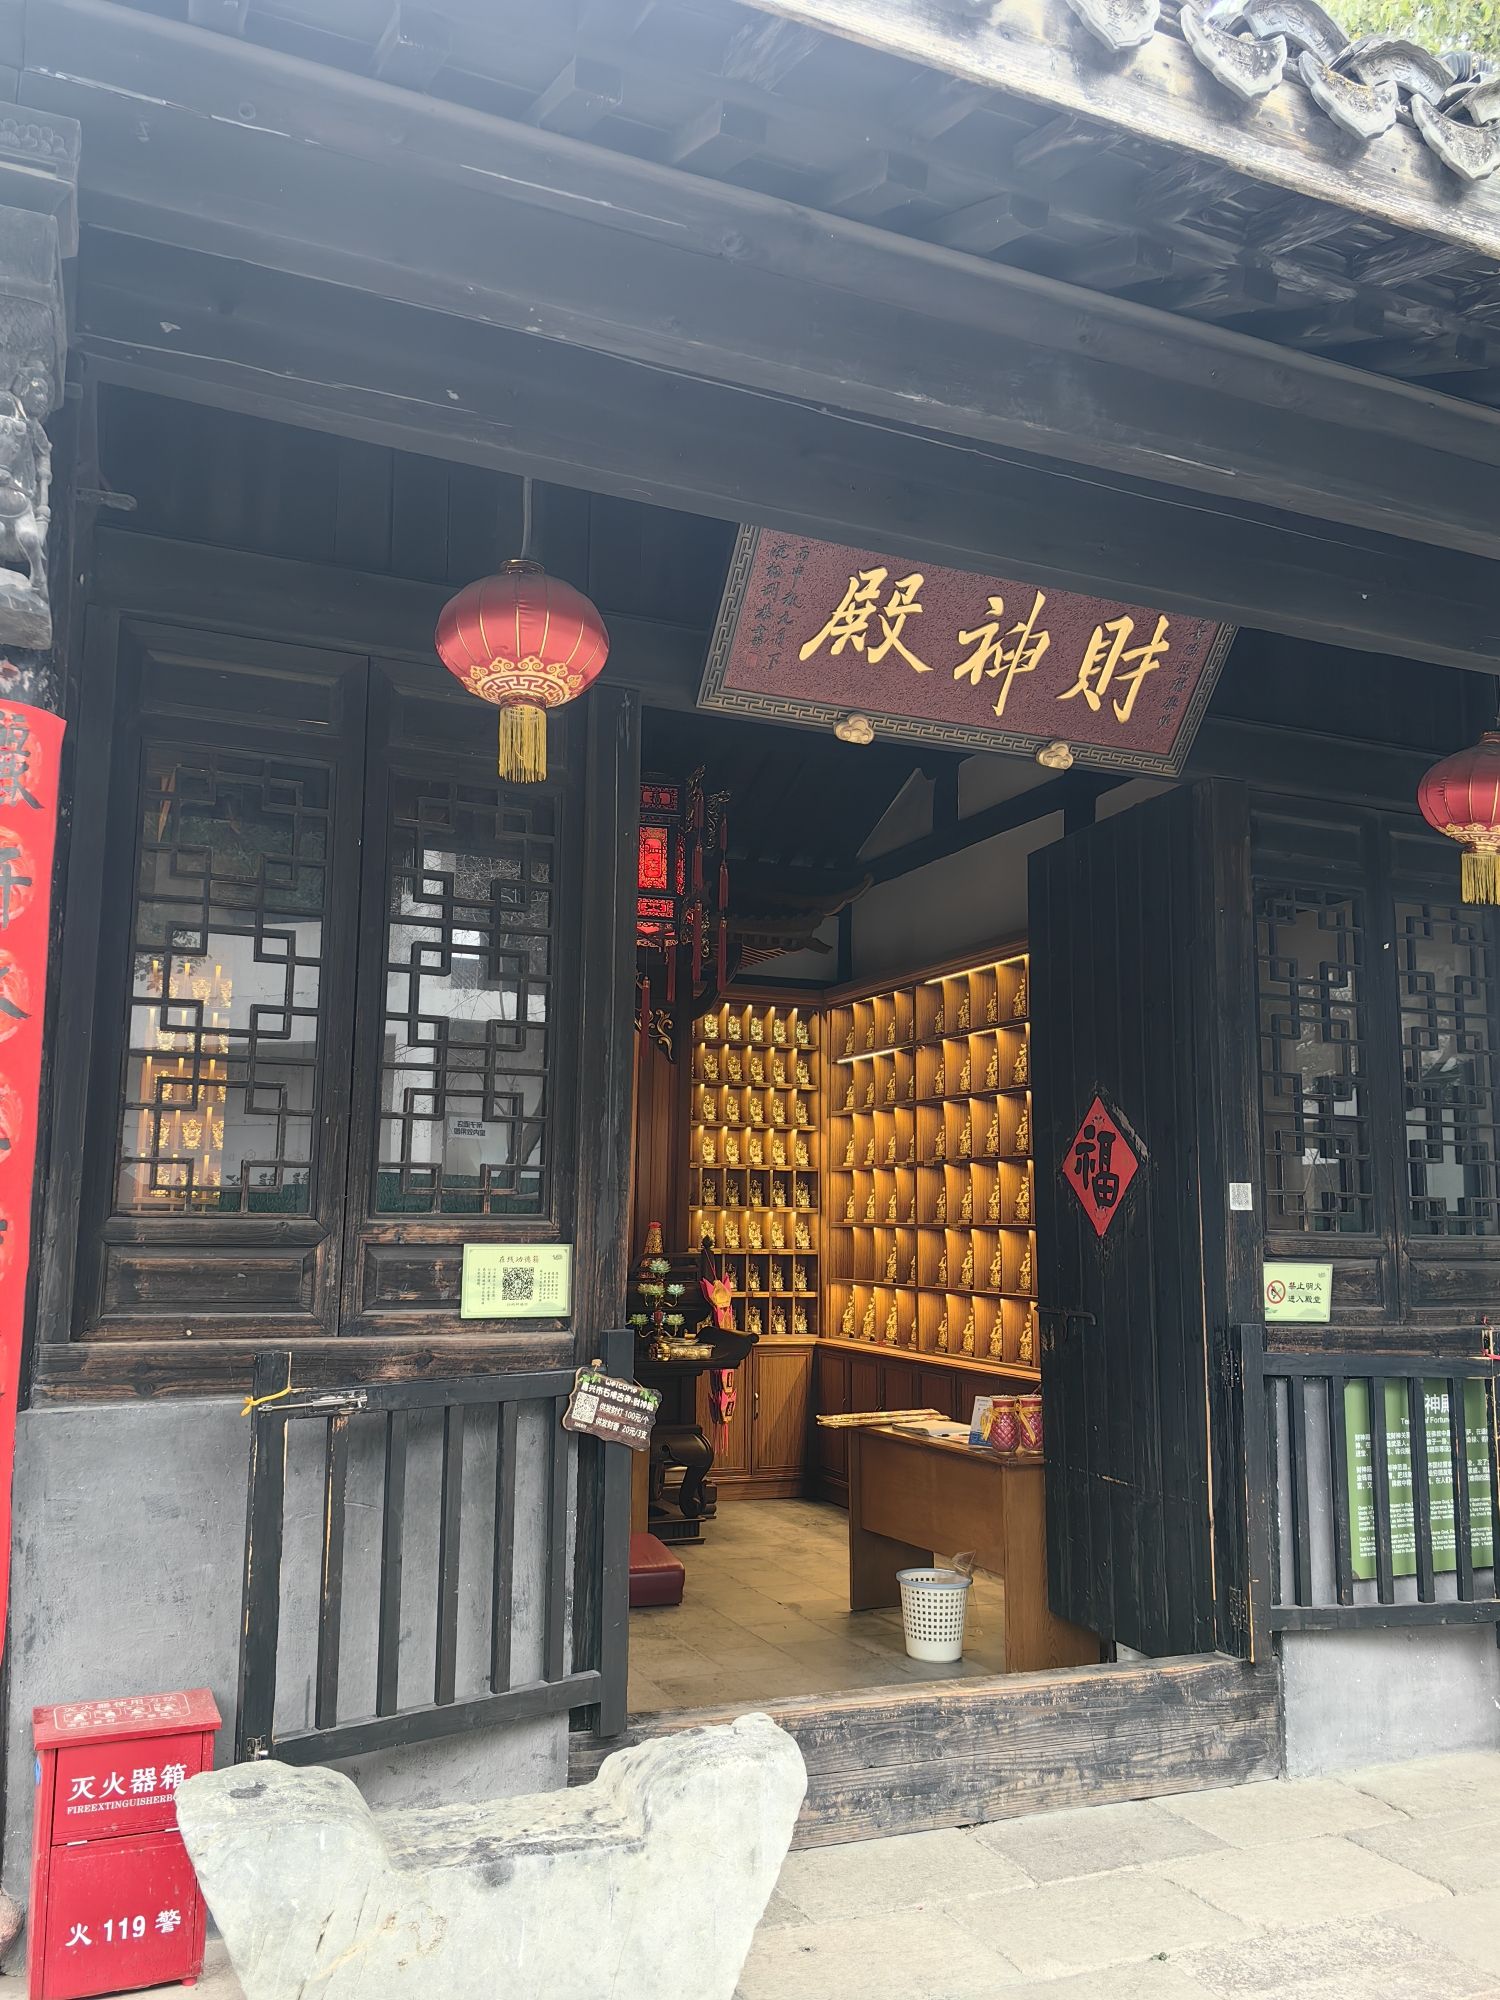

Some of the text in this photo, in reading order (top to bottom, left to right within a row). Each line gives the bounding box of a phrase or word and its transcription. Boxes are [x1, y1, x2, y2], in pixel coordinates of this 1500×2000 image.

[1075, 1124, 1120, 1208] 福
[1287, 1295, 1321, 1304] 进入殿堂
[1288, 1281, 1322, 1291] 禁止明火
[68, 1764, 187, 1800] 灭火器箱
[67, 1794, 178, 1815] FIREEXTINGUISHERB
[65, 1908, 182, 1947] 火 119 警
